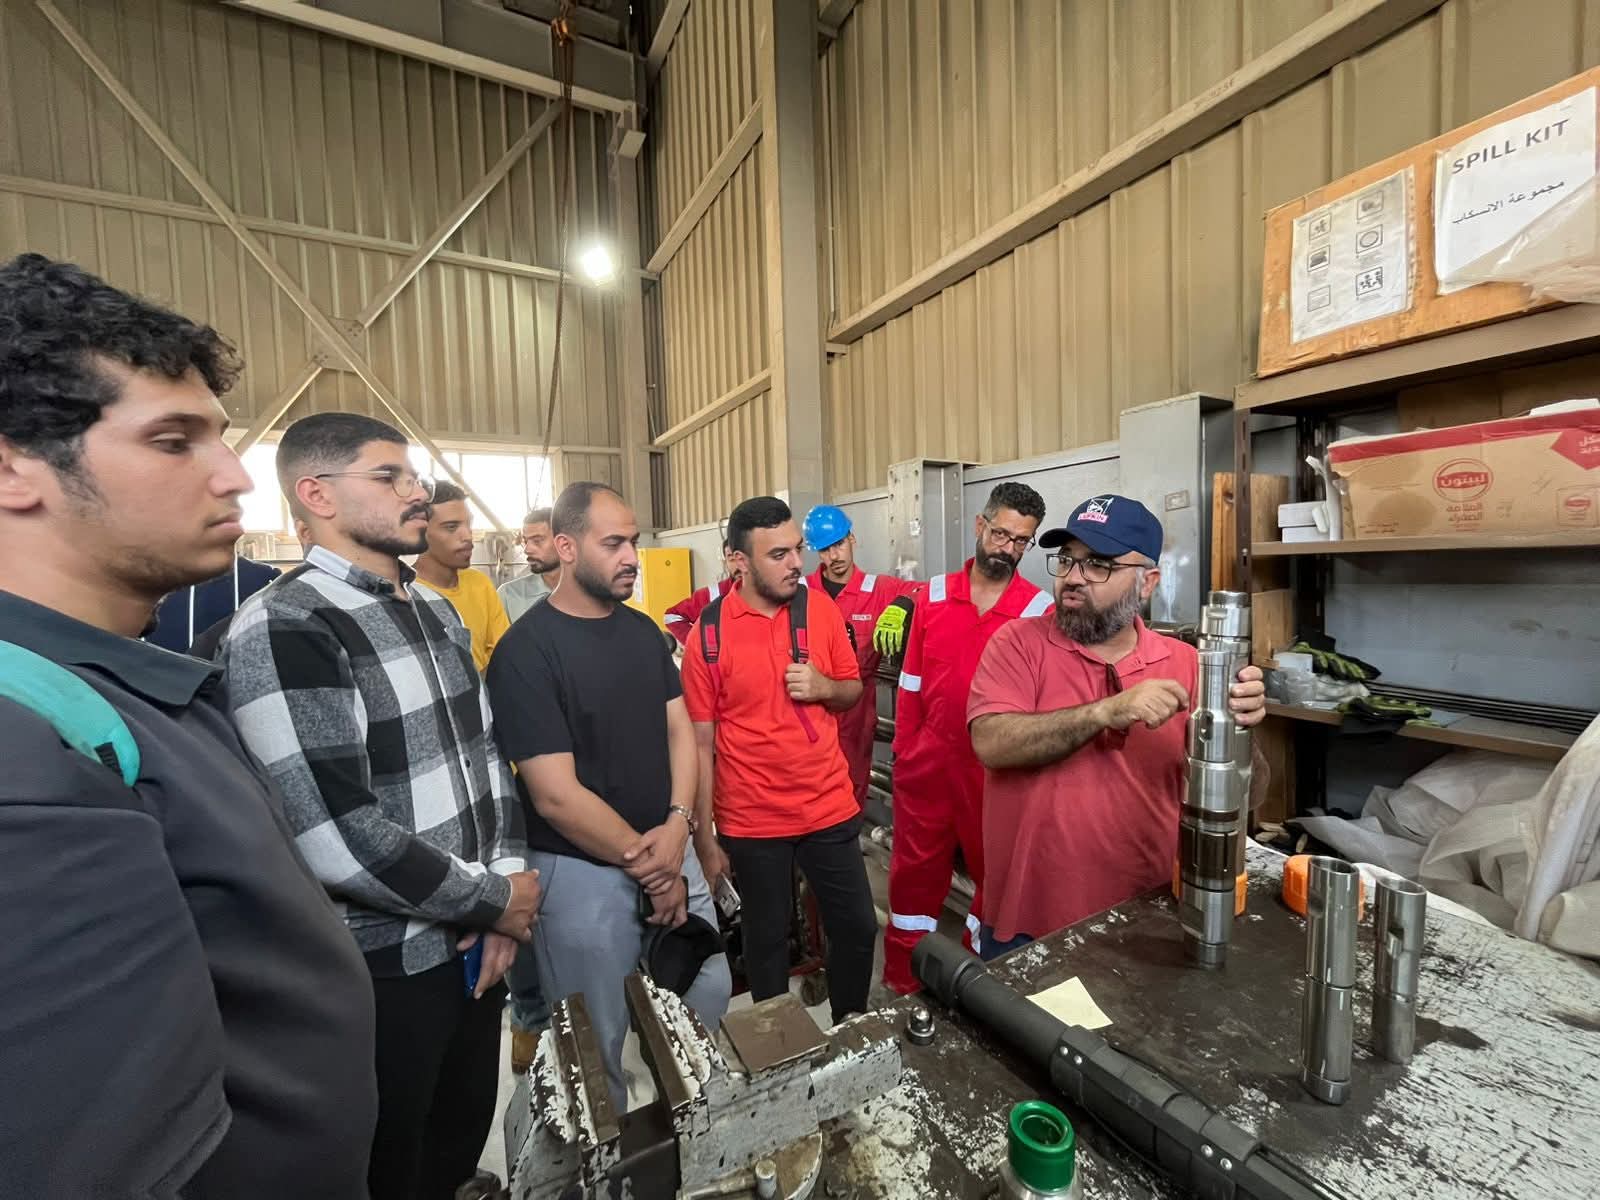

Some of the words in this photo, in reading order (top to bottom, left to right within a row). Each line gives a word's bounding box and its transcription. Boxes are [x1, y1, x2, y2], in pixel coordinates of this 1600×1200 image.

[1452, 140, 1517, 174] SPILL
[1526, 119, 1570, 147] KIT
[1508, 181, 1565, 203] مجموعة
